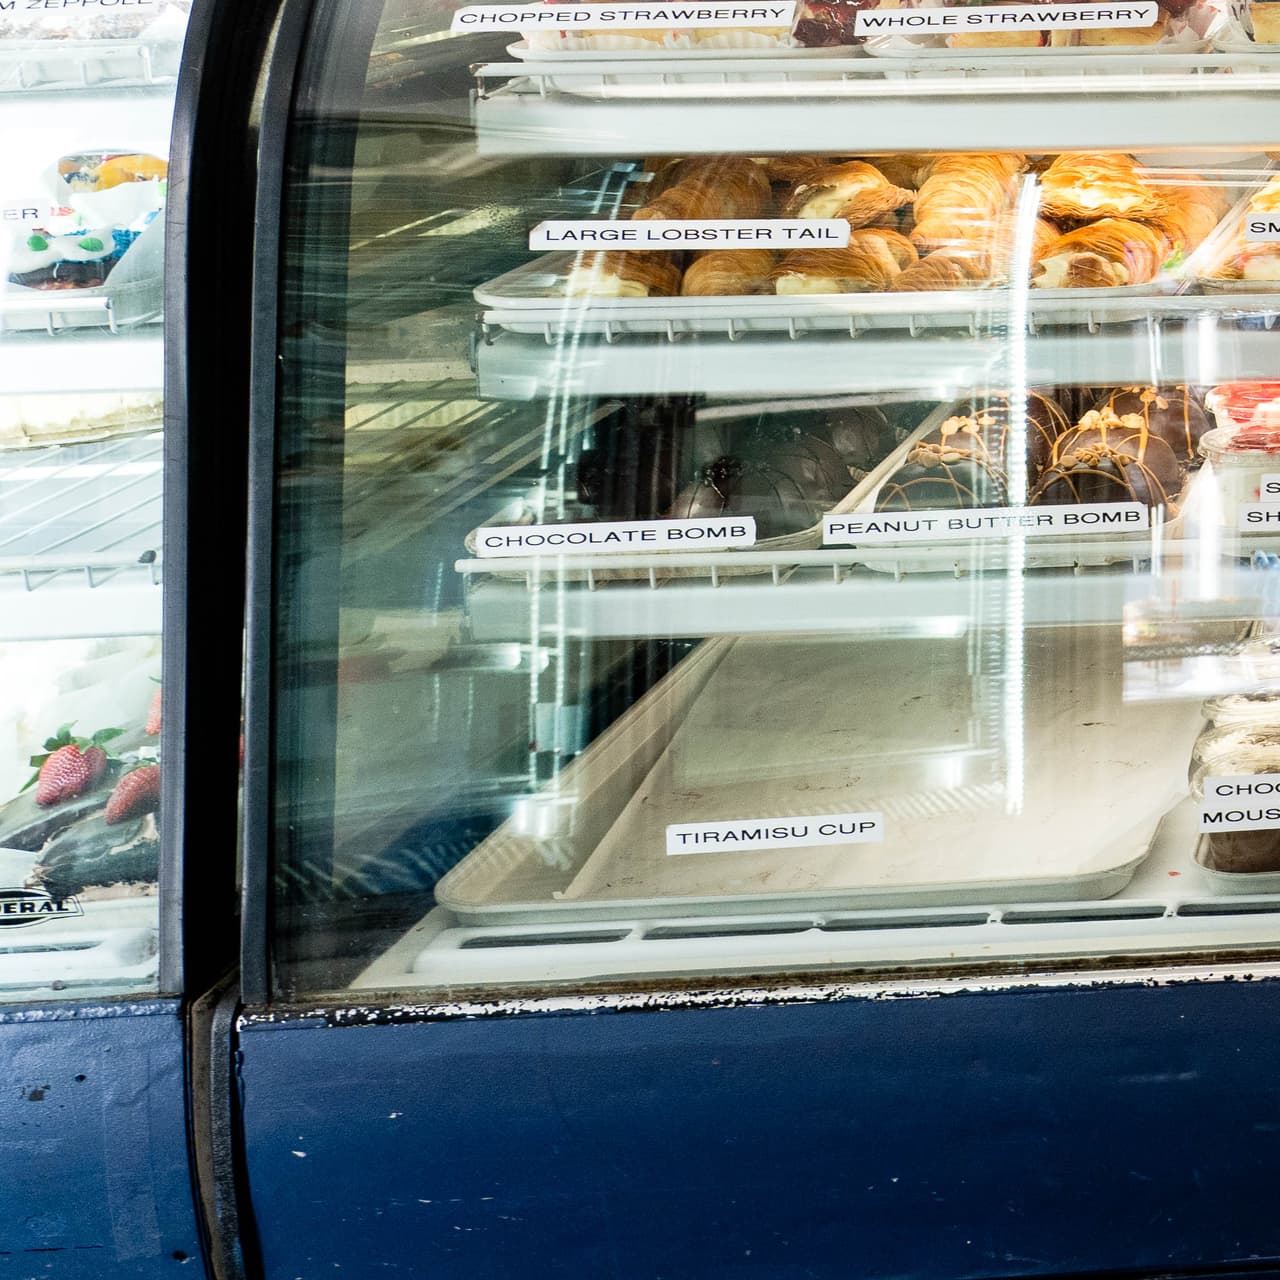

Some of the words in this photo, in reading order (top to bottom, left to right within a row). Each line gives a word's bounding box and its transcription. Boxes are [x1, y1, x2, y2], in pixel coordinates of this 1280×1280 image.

[459, 11, 591, 24] CHOPPED
[599, 8, 785, 21] STRAWBERRY
[862, 15, 958, 28] WHOLE
[966, 9, 1150, 25] STRAWBERRY
[546, 229, 637, 241] LARGE
[647, 228, 773, 241] LOBSTER
[781, 227, 839, 240] TAIL
[829, 519, 938, 535] PEANUT
[948, 514, 1054, 530] BUTTER
[1063, 511, 1141, 525] BOMB
[484, 529, 657, 548] CHOCOLATE
[667, 526, 747, 540] BOMB
[676, 825, 808, 845] TIRAMISU
[818, 821, 876, 836] CUP
